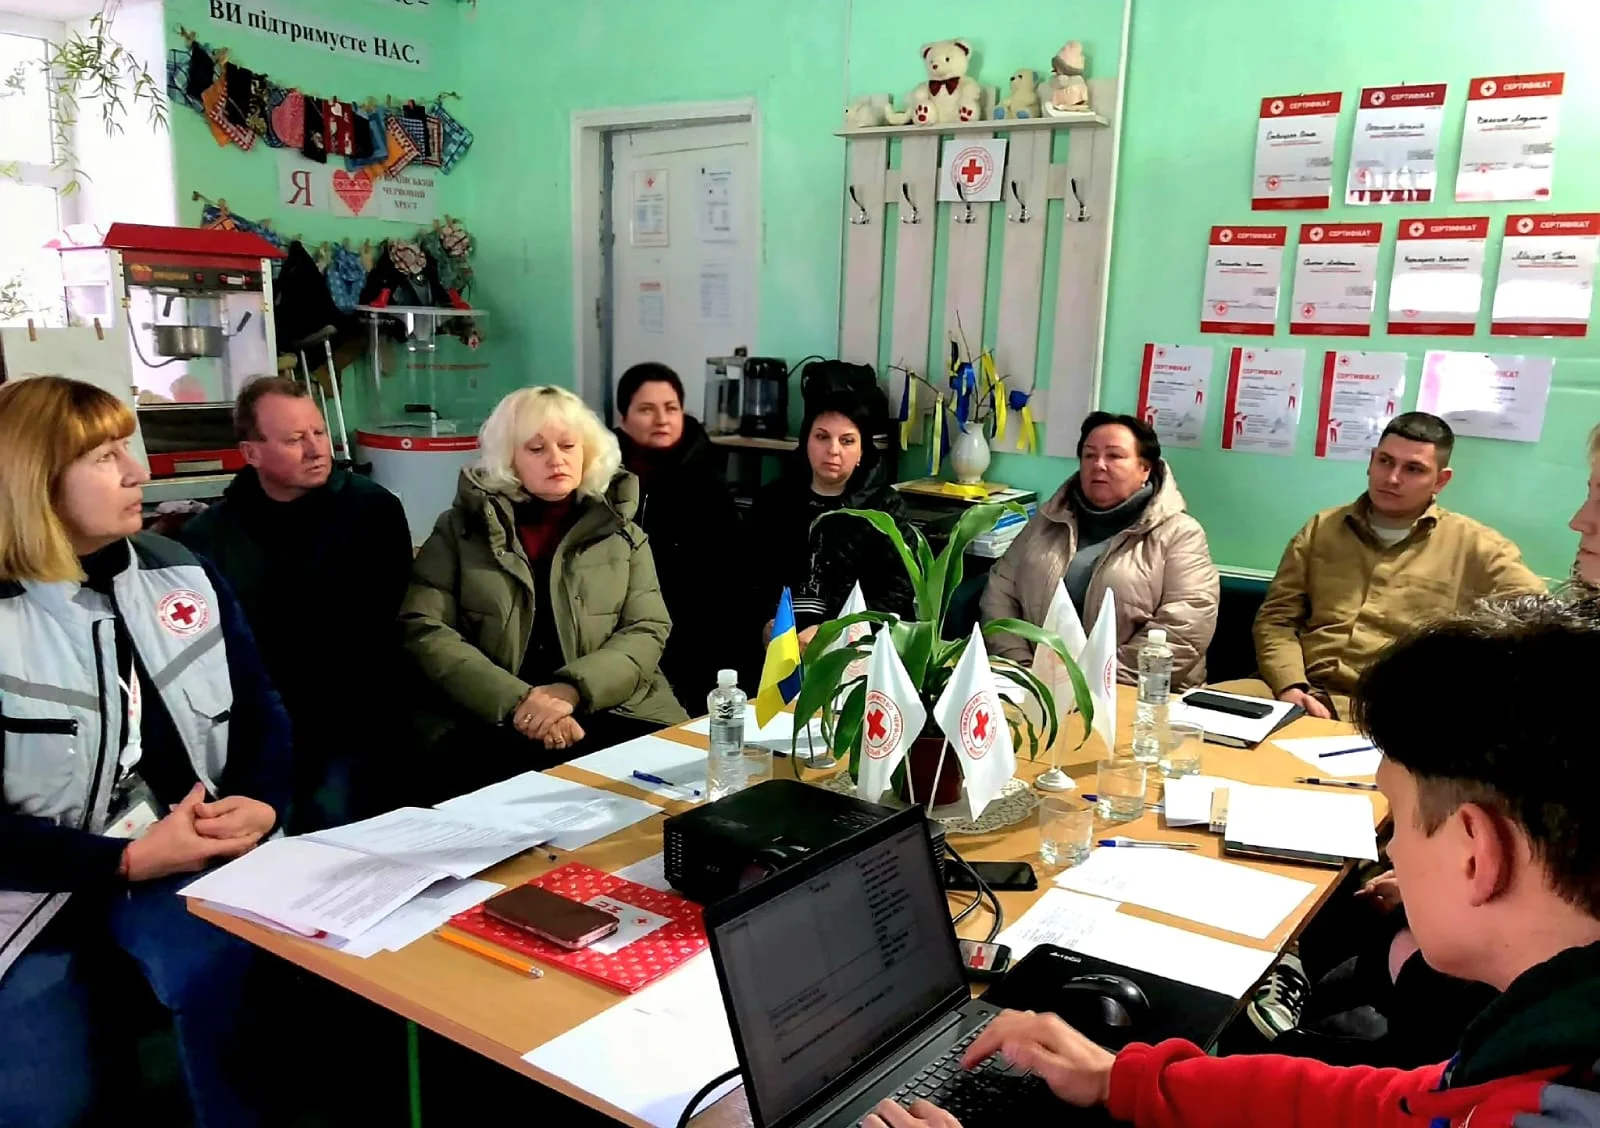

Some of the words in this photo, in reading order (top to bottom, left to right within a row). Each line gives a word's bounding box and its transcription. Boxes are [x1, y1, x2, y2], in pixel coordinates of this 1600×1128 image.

[209, 0, 242, 24] ВИ
[374, 37, 420, 65] НАС.
[287, 170, 314, 207] Я
